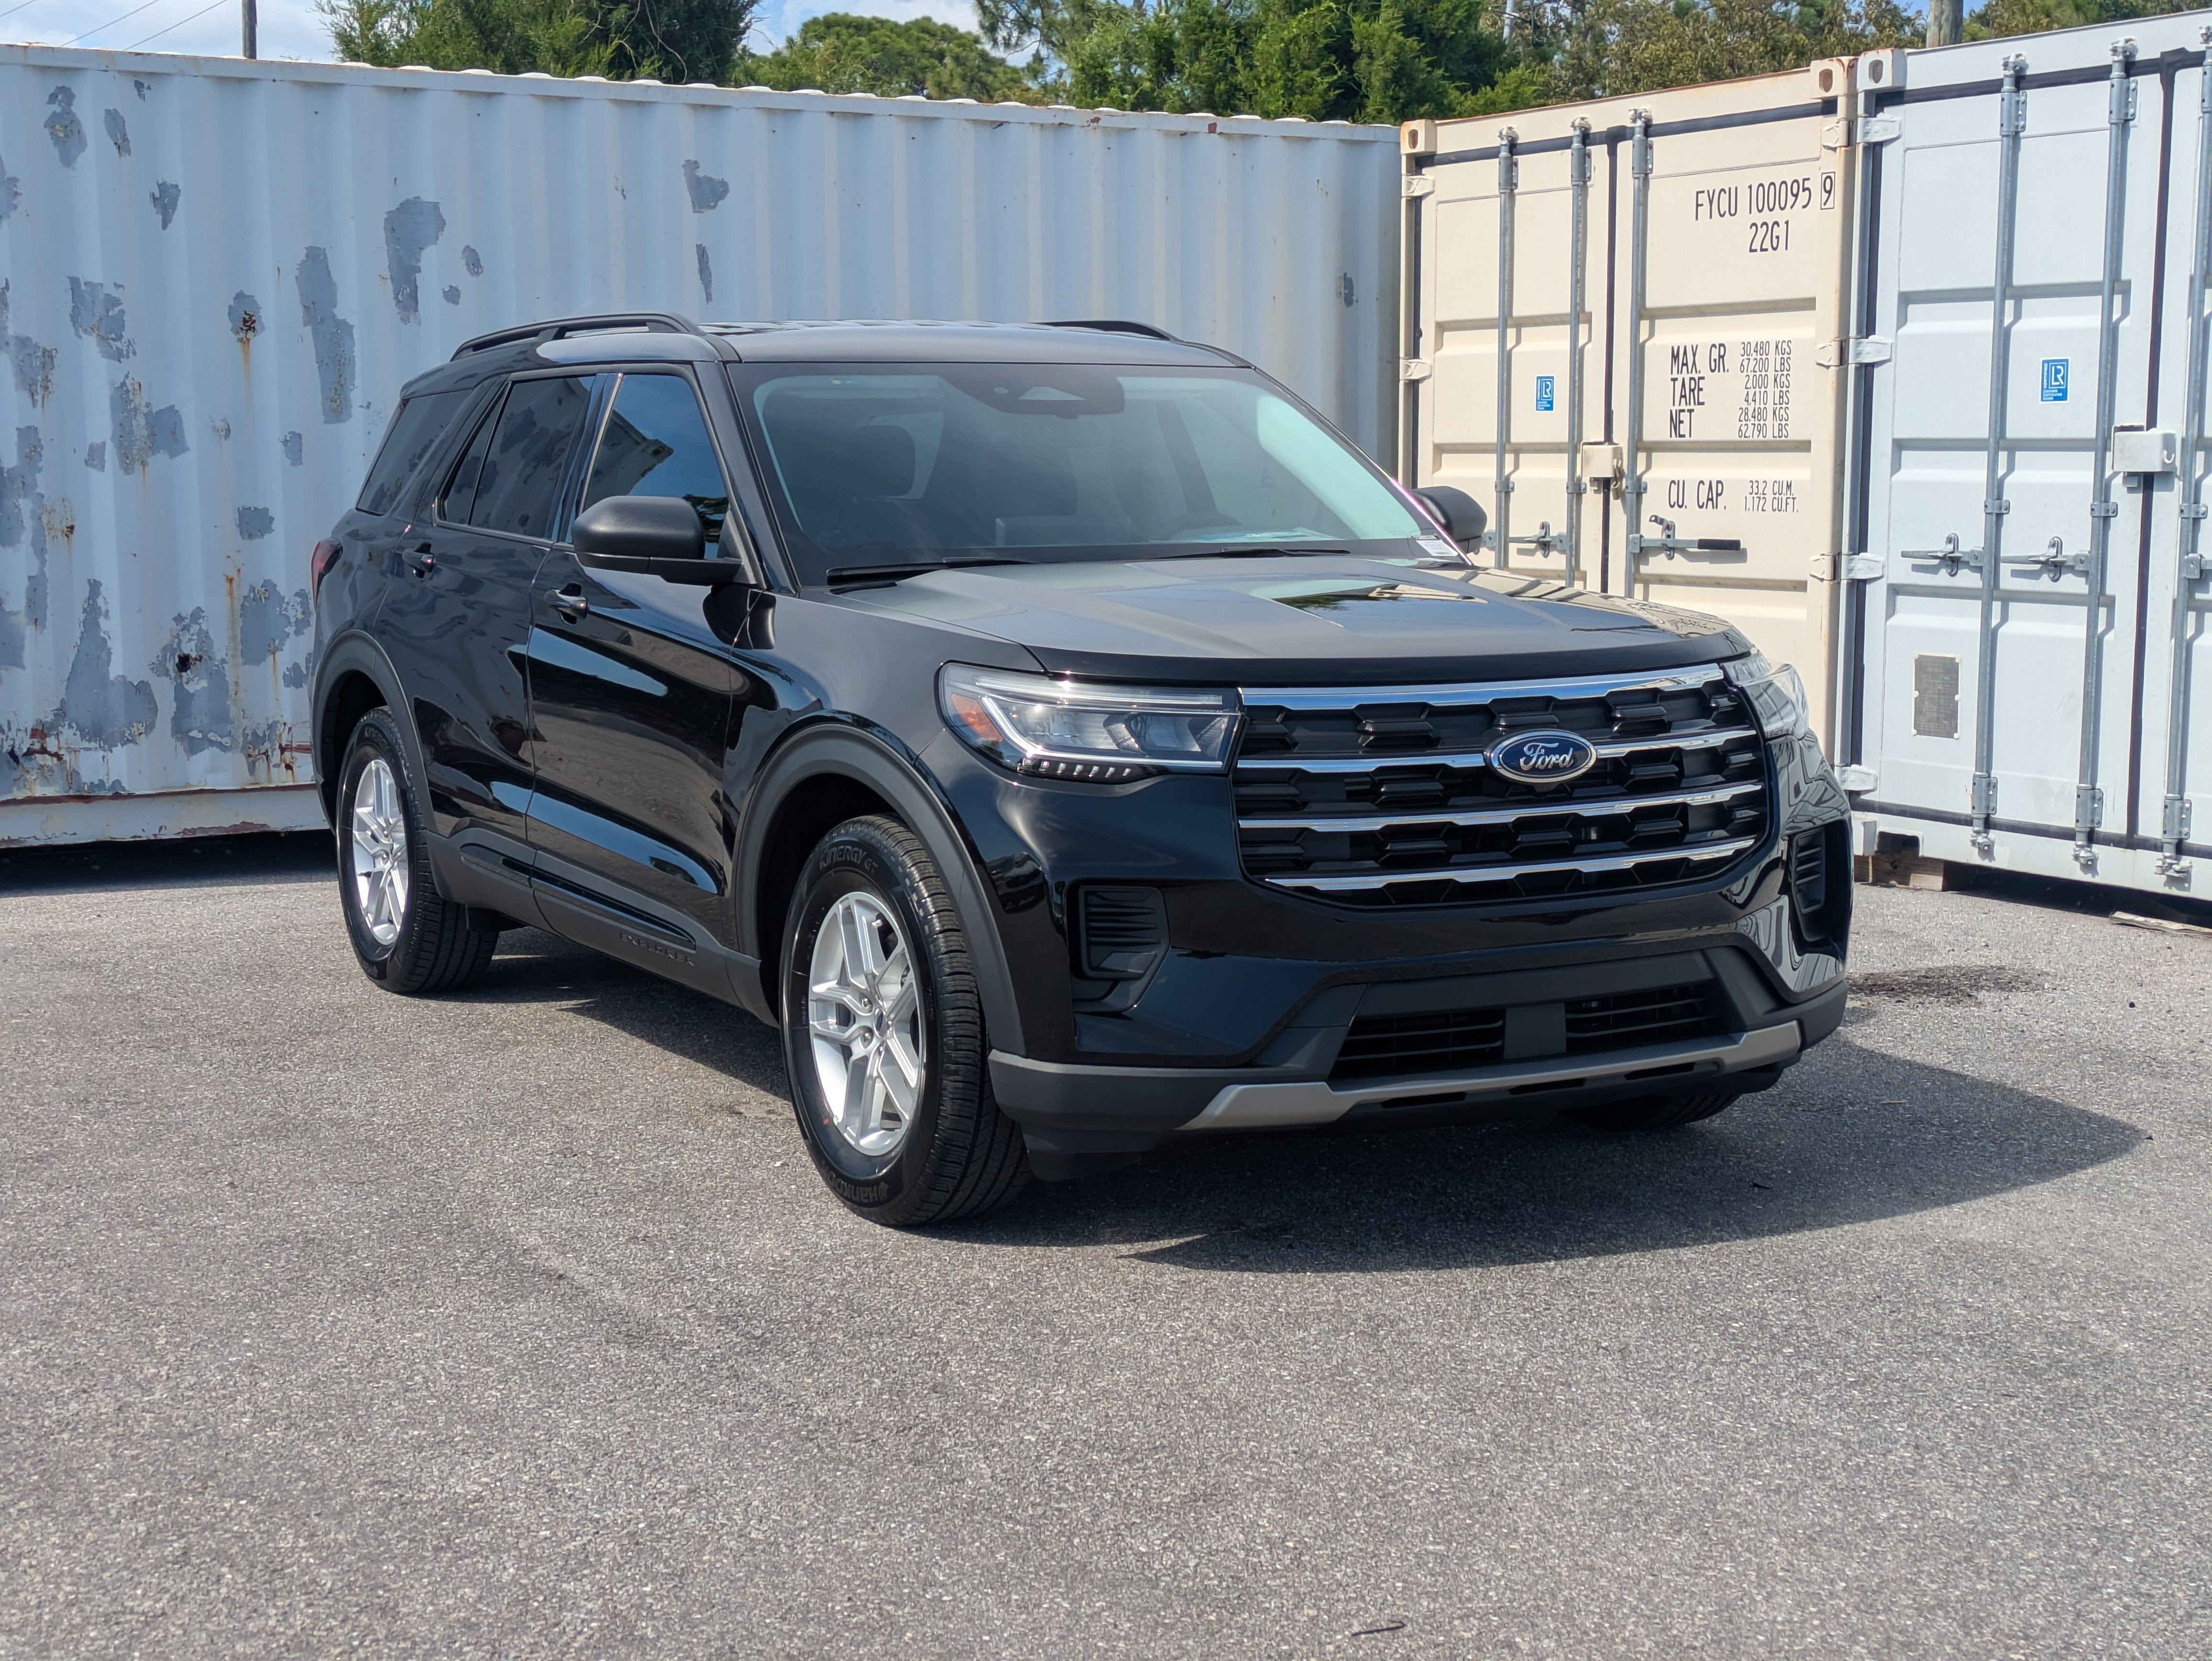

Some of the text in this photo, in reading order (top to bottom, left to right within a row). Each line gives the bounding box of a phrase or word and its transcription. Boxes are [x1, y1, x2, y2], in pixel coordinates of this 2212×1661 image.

[1695, 175, 1834, 221] FYCU 100095 9
[1748, 220, 1790, 253] 22G1
[1670, 344, 1701, 375] MAX.
[1709, 343, 1730, 373] GR.
[1775, 340, 1792, 356] KGS
[1774, 356, 1791, 373] LBS
[1670, 376, 1705, 407] TARE
[1773, 373, 1791, 389] KGS
[1773, 390, 1790, 405] LBS
[1670, 408, 1695, 438] NET
[1772, 406, 1789, 422] KGS
[1772, 423, 1789, 438] LBS
[1668, 479, 1687, 509] CU.
[1696, 480, 1726, 509] CAP.
[1748, 480, 1768, 496] 33.2
[1520, 742, 1574, 771] Ford
[819, 845, 879, 874] KINERGY GT
